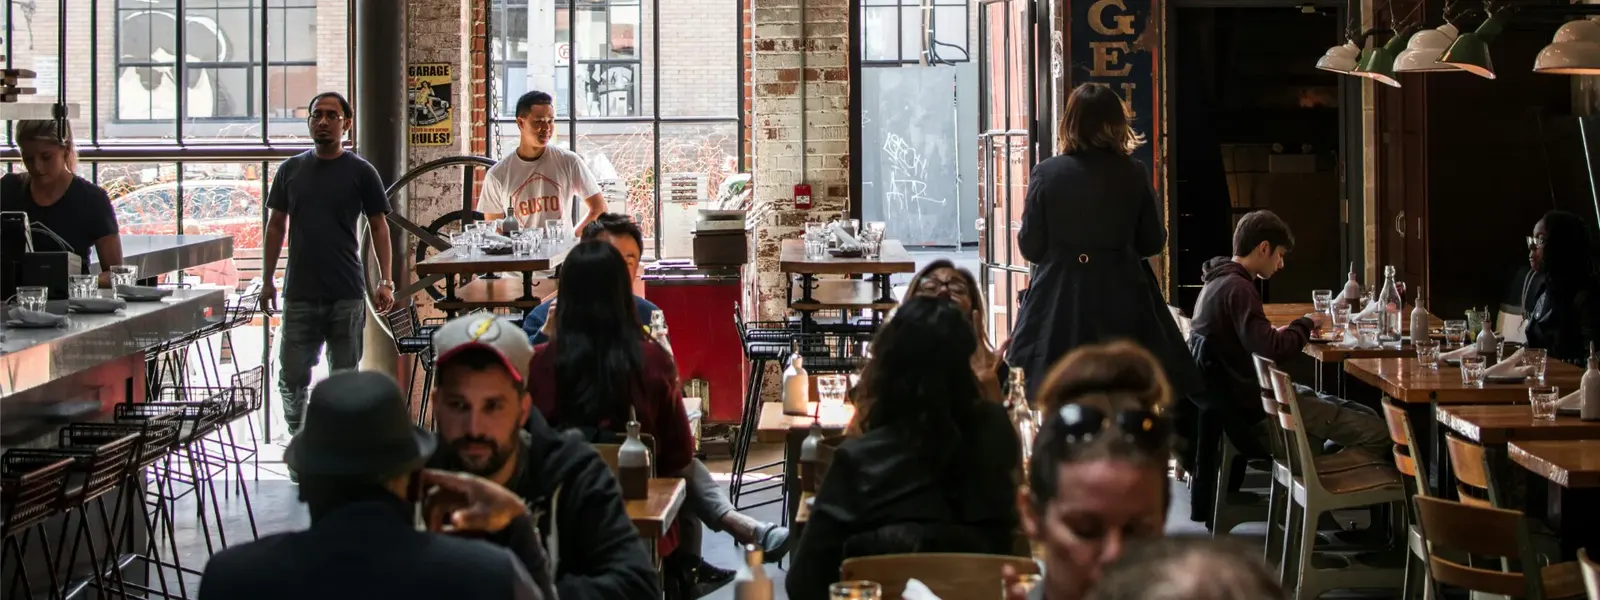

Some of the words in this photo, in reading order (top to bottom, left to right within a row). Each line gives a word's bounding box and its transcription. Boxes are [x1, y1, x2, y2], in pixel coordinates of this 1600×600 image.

[409, 65, 449, 77] GARAGE
[411, 132, 450, 144] RULES!
[519, 195, 559, 216] GUSTO
